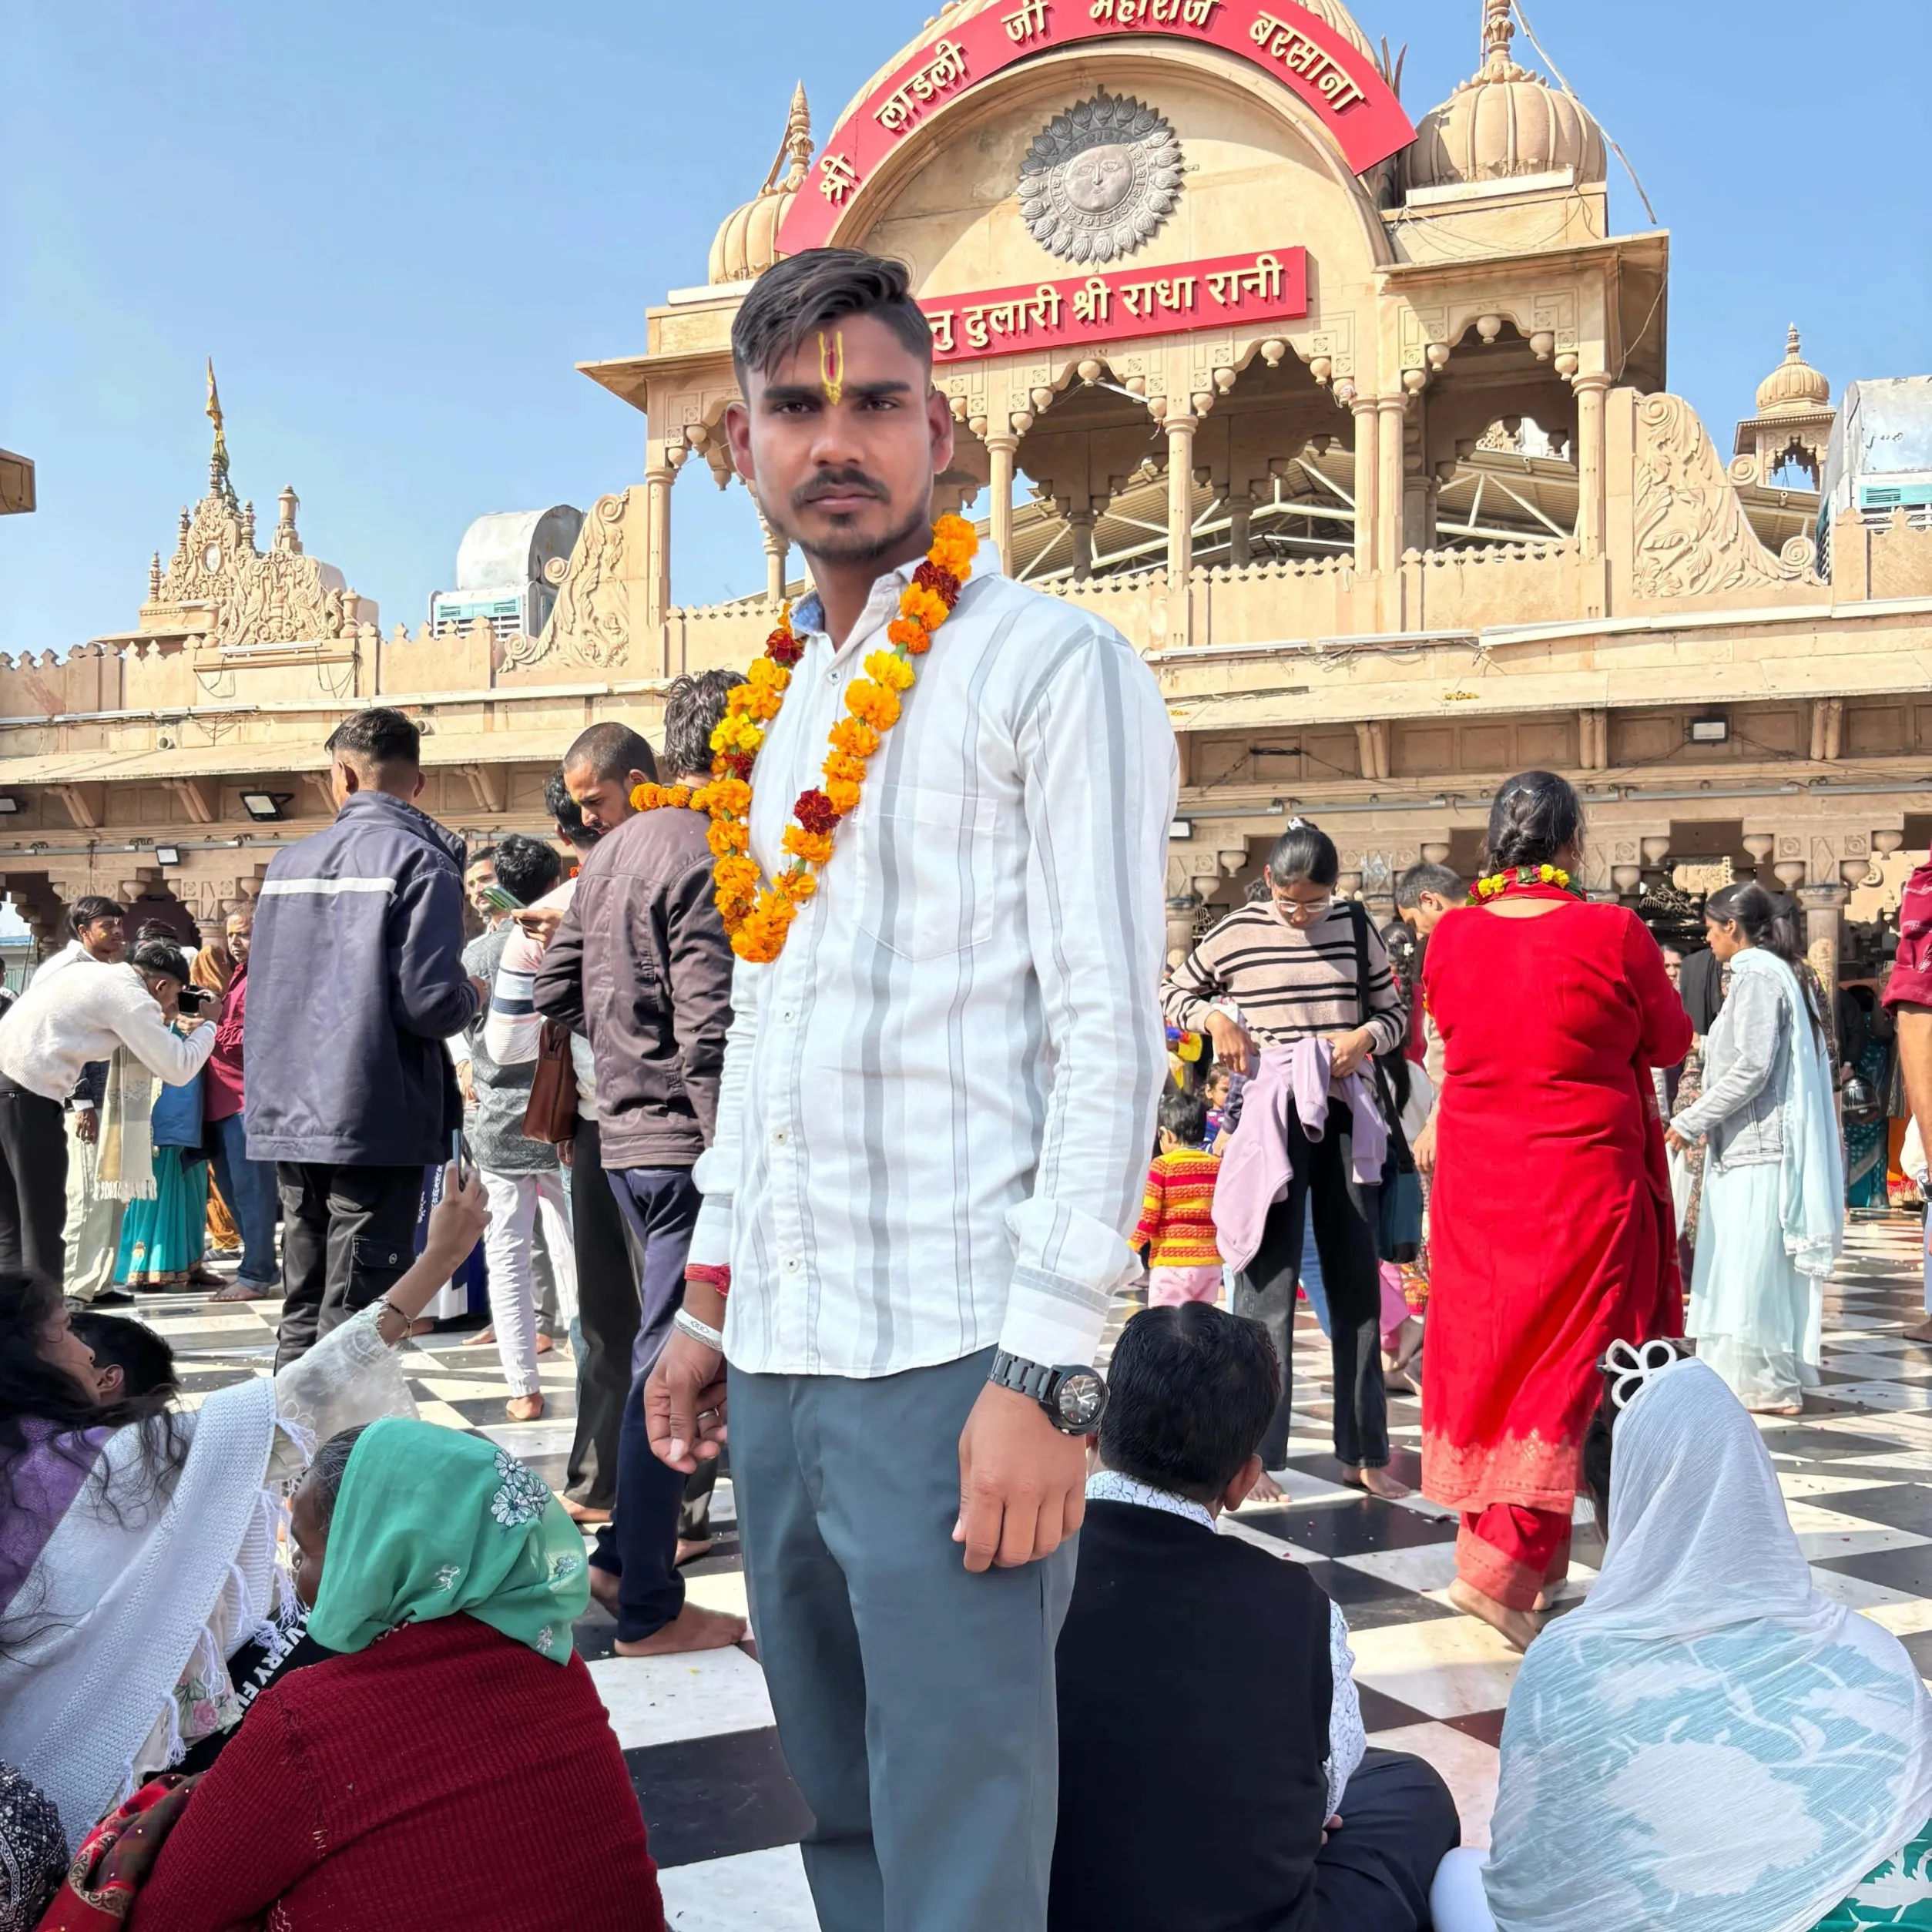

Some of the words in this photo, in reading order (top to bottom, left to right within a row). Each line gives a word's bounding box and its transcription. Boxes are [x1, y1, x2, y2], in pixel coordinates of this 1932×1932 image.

[820, 153, 855, 201] श्री
[1249, 10, 1365, 109] बरसाना
[925, 310, 954, 351] नु
[962, 284, 1062, 347] दुलारी
[1072, 277, 1111, 320] श्री
[1120, 277, 1196, 316] राधा
[1206, 254, 1283, 304] रानी
[253, 1627, 307, 1685] VERY
